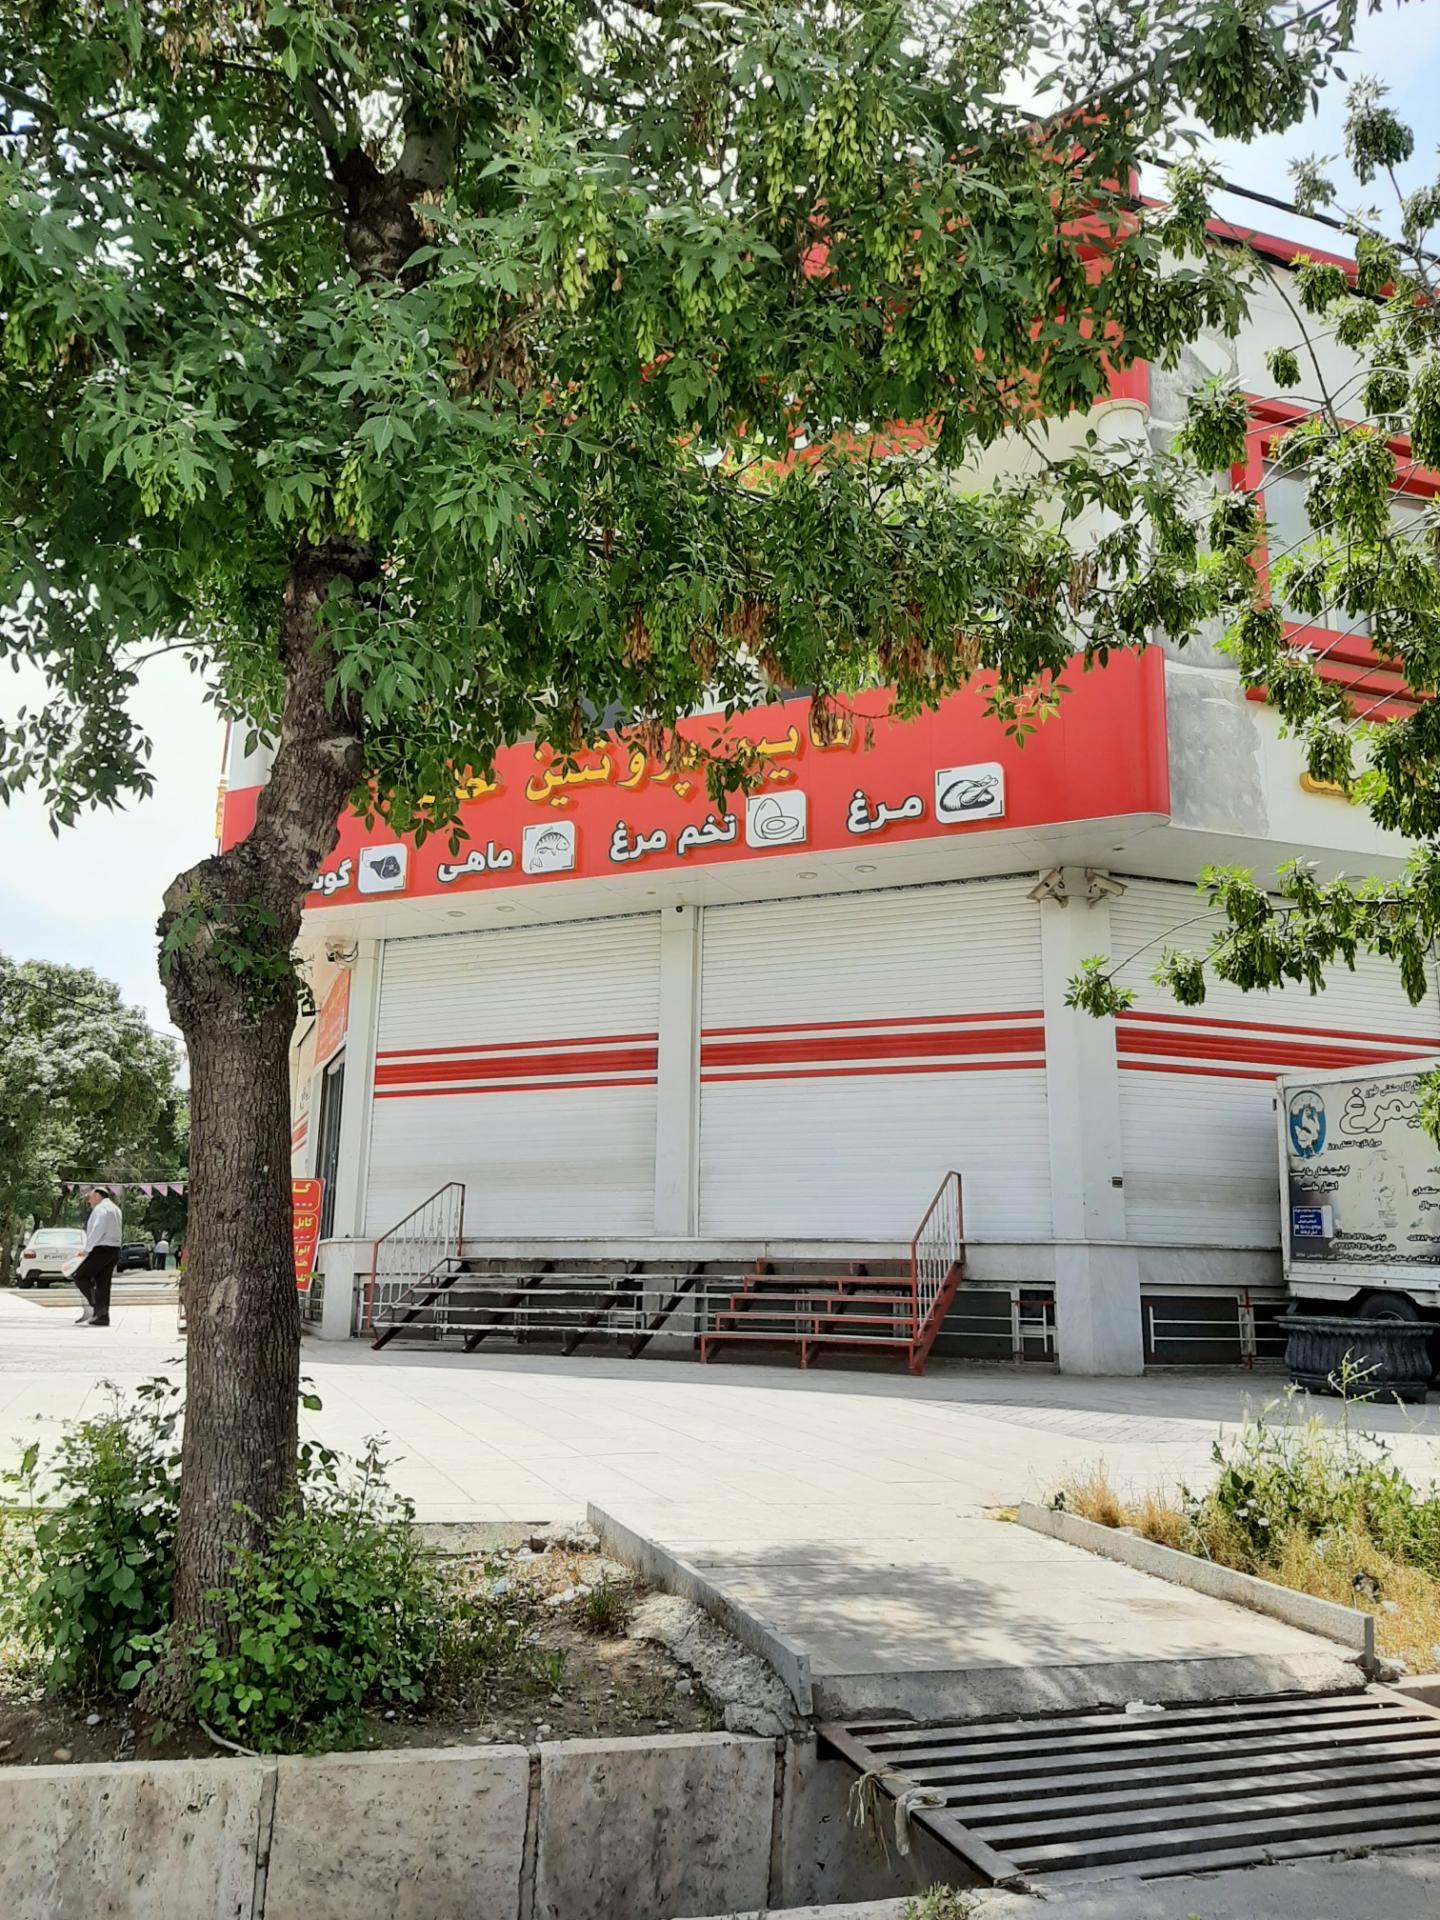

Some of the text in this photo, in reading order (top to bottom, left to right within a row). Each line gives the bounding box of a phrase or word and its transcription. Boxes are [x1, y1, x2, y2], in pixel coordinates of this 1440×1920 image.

[846, 789, 924, 834] مرغ
[609, 813, 737, 863] تخم مرغ
[437, 841, 513, 883] ماهی
[1340, 1087, 1421, 1135] یمرغ
